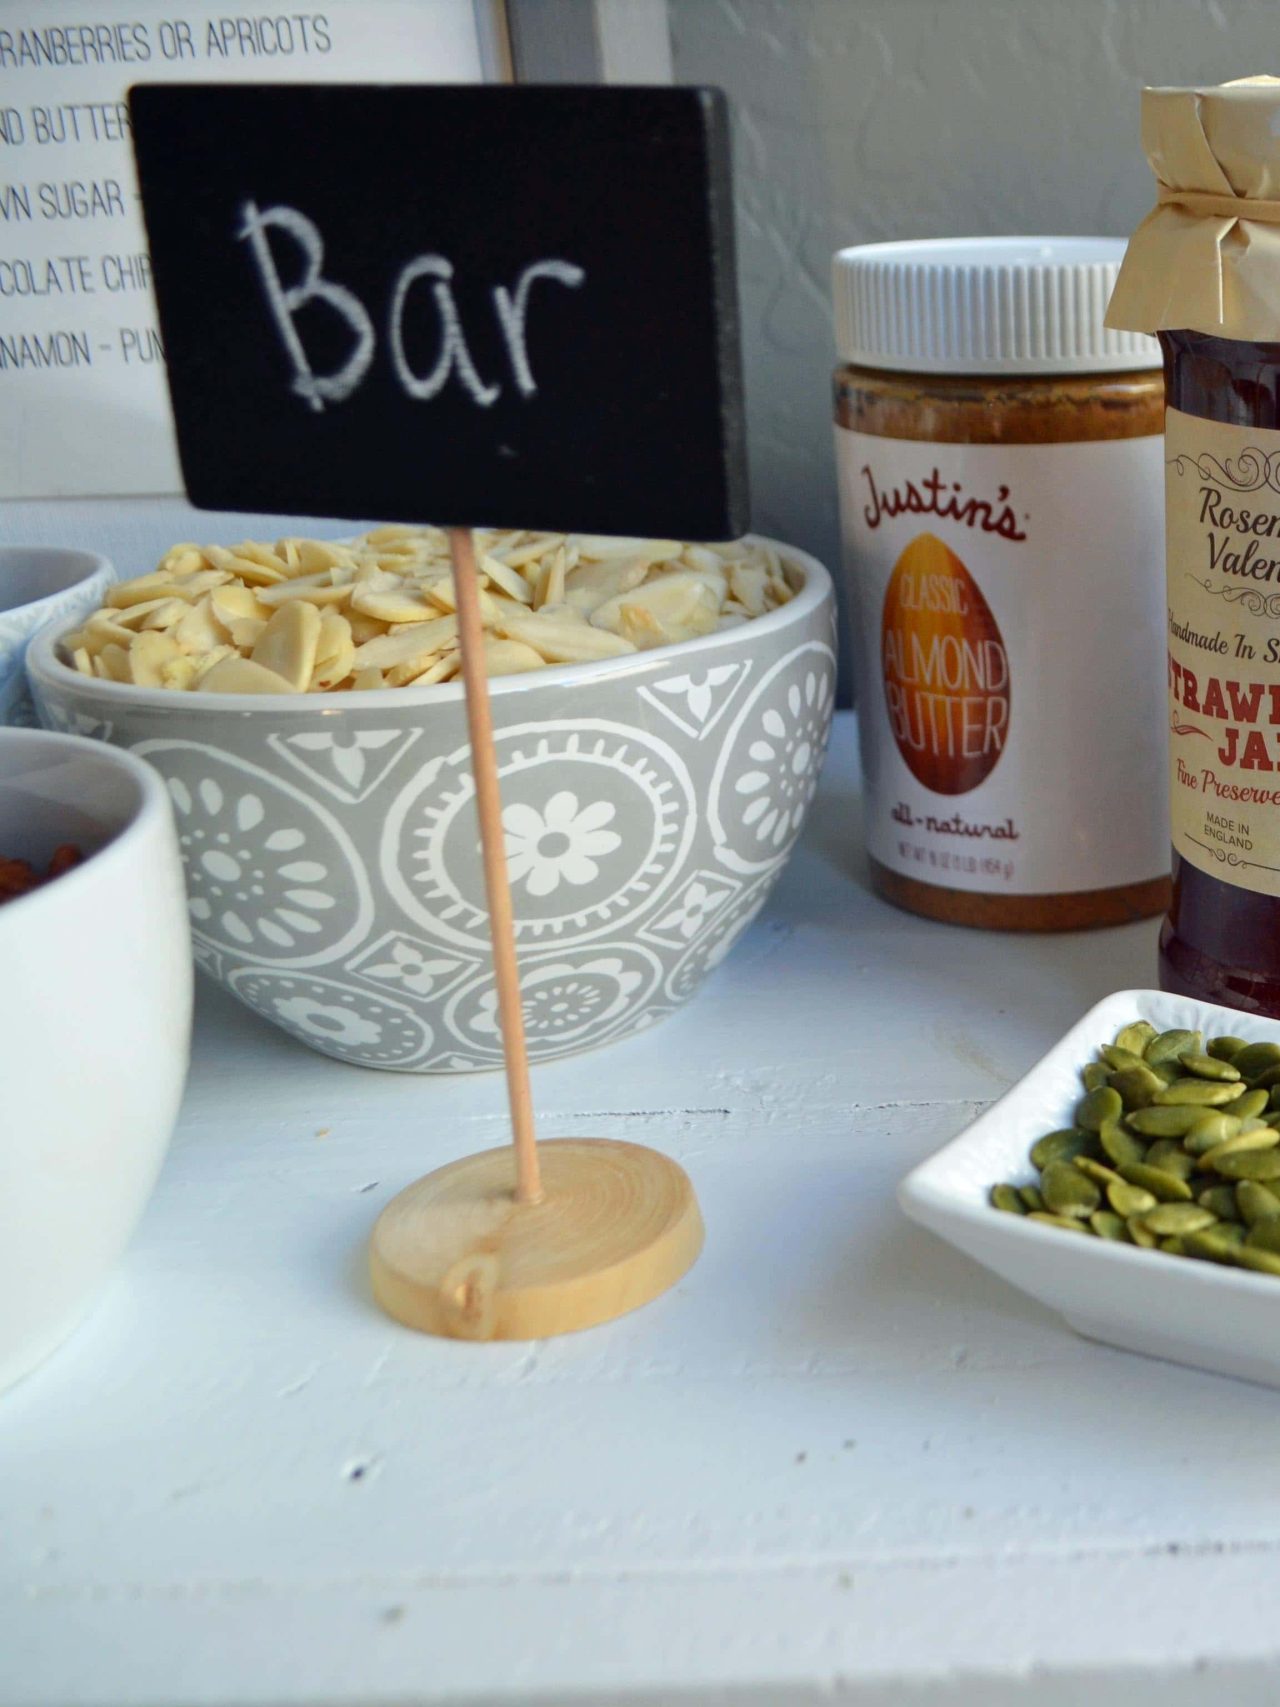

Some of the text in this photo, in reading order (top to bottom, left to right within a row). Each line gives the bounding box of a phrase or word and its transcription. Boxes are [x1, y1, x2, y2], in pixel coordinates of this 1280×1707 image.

[160, 21, 194, 60] OR
[206, 14, 332, 58] APRICOTS
[38, 180, 125, 220] SUGAR
[236, 199, 585, 413] Bar
[862, 464, 1027, 541] Justin's
[900, 572, 968, 616] CLASSIC
[1168, 609, 1229, 656] Handmade
[1234, 634, 1257, 660] In
[884, 628, 1008, 692] ALMOND
[887, 680, 1008, 760] BUTTER
[1176, 758, 1199, 790] Fine
[891, 801, 1021, 840] all-natural
[1204, 824, 1253, 851] ENGLAND
[1206, 811, 1250, 837] MADE IN
